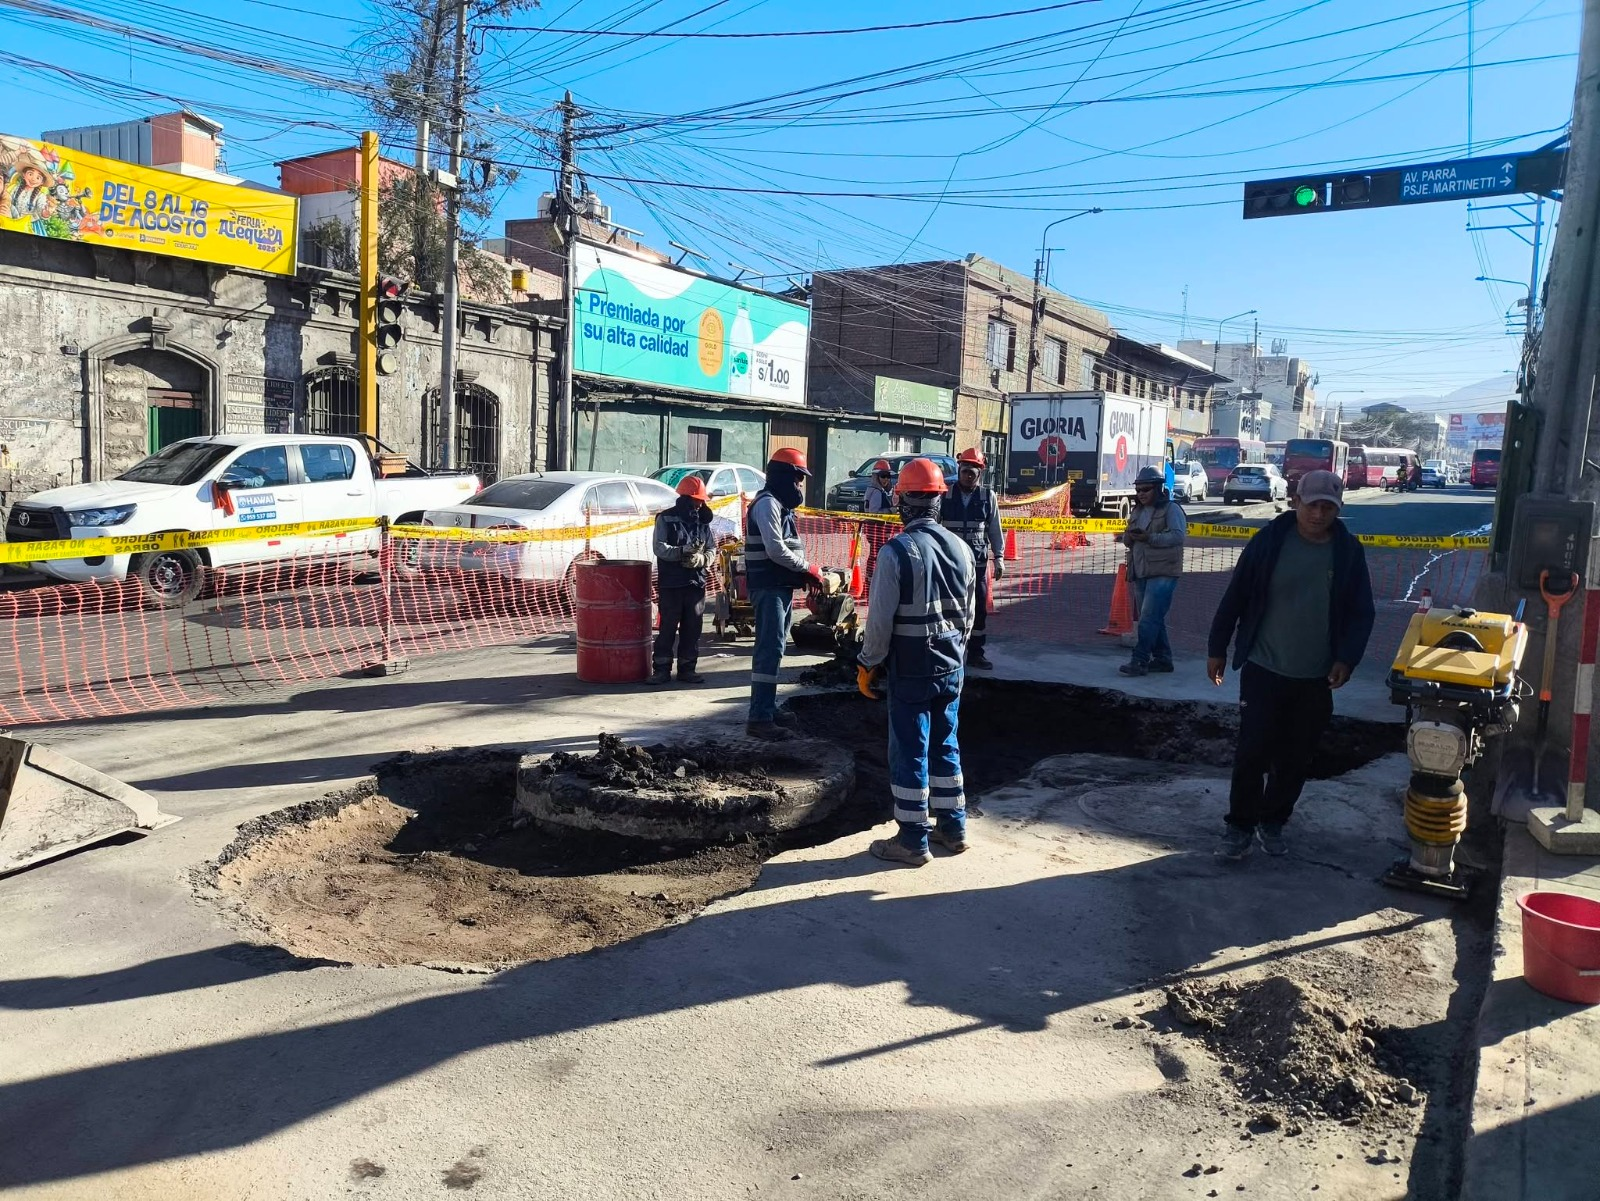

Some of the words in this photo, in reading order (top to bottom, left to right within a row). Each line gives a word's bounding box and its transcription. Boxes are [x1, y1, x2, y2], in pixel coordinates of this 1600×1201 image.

[1404, 172, 1418, 183] AV.
[1422, 168, 1456, 181] PARRA
[1403, 183, 1431, 196] PSJE.
[1433, 177, 1496, 194] MARTINETTI
[102, 181, 140, 207] DEL
[144, 190, 157, 209] 8
[159, 194, 185, 215] AL
[191, 199, 209, 218] 16
[99, 202, 126, 225] DE
[129, 208, 207, 238] AGOSTO
[237, 215, 261, 228] FERIA
[589, 293, 660, 328] Premiada
[663, 315, 686, 334] por
[584, 323, 602, 341] su
[606, 325, 636, 348] alta
[640, 334, 689, 358] calidad
[228, 375, 258, 385] ESCUELA
[228, 406, 258, 415] ESCUELA
[228, 424, 248, 434] OMAR
[1021, 417, 1087, 441] GLORIA
[1110, 411, 1135, 441] GLORIA
[246, 496, 274, 505] HAWAI
